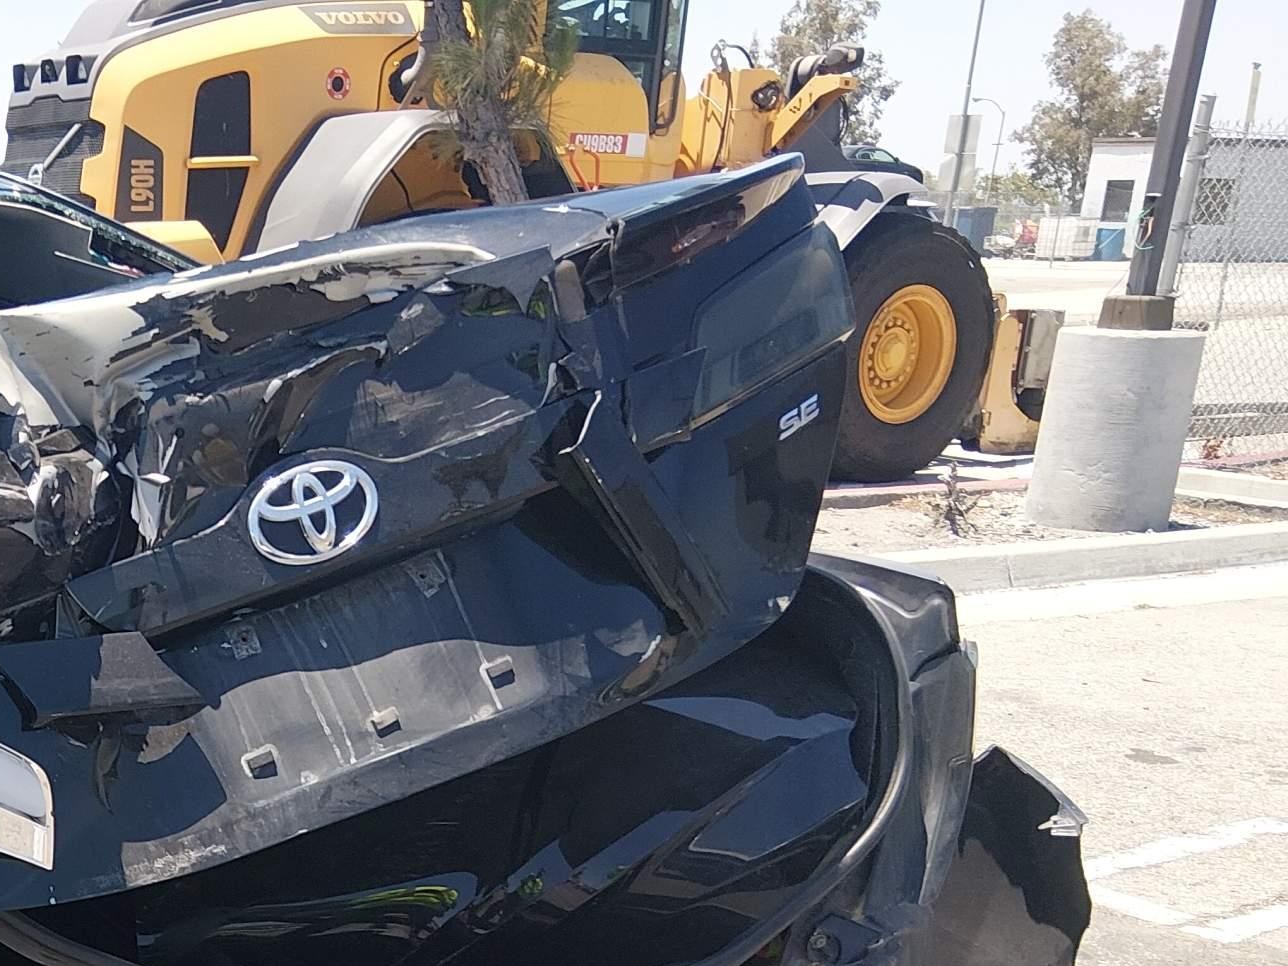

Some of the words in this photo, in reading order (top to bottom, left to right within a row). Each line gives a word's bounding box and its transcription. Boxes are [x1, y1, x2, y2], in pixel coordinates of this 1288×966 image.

[315, 11, 405, 24] VOLVO
[130, 159, 154, 212] L90H
[779, 393, 820, 441] SE
